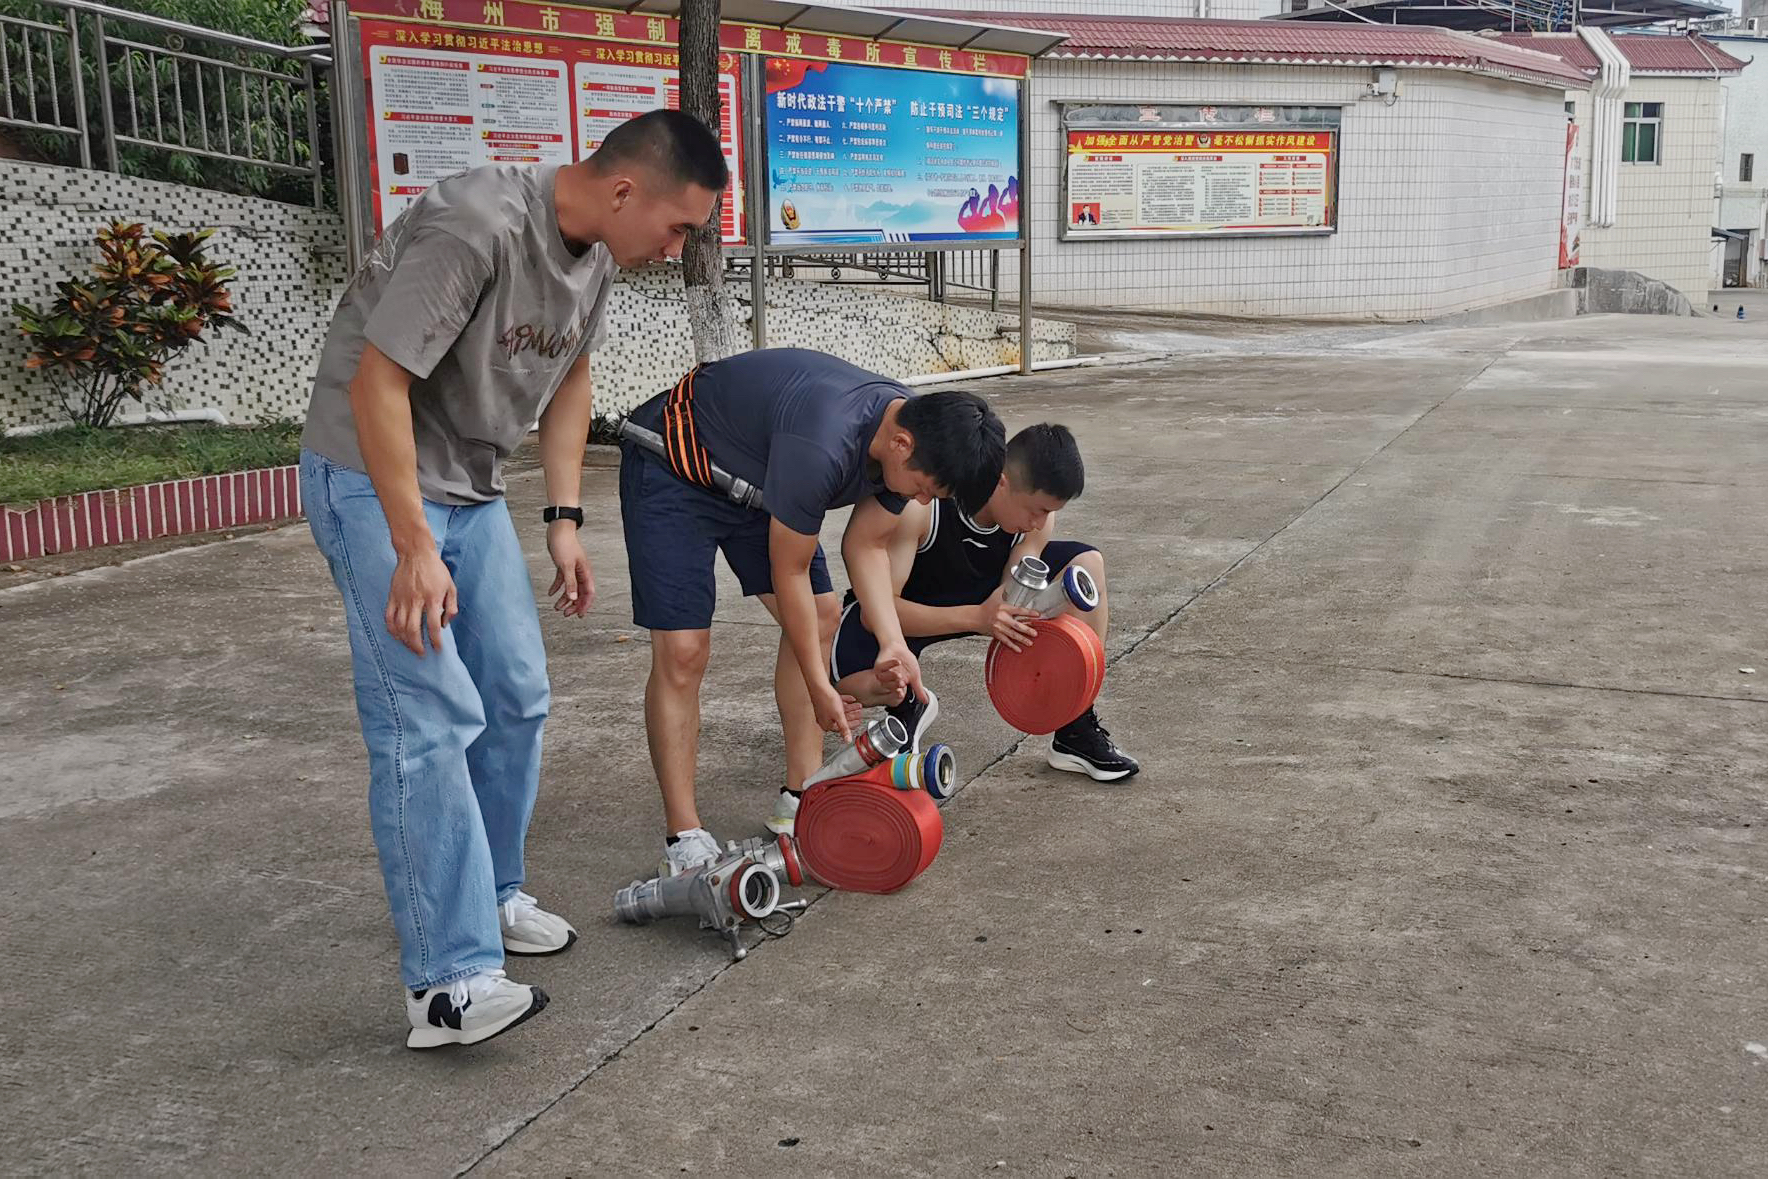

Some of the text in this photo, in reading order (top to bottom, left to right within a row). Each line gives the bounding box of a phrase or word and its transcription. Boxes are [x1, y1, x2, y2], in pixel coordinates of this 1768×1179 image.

[395, 29, 544, 54] 深入学习贯彻习近平法治思想
